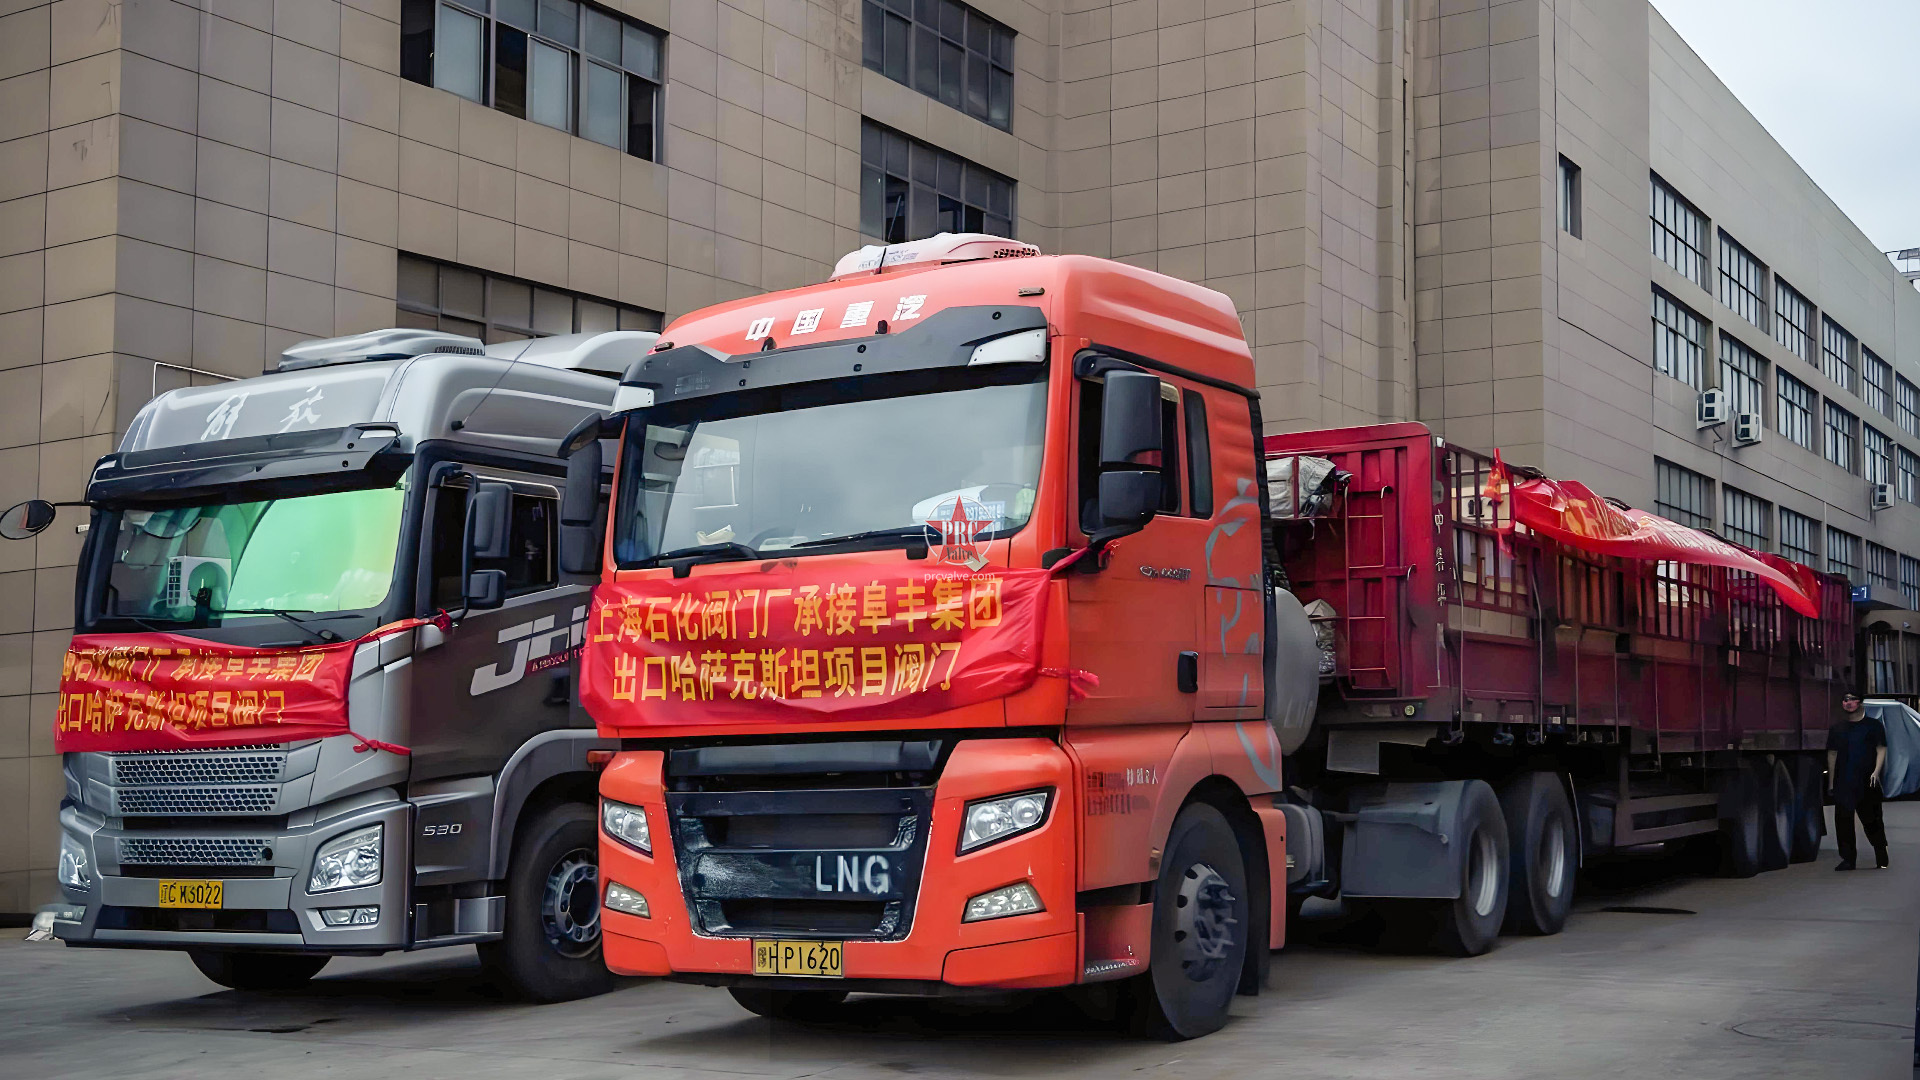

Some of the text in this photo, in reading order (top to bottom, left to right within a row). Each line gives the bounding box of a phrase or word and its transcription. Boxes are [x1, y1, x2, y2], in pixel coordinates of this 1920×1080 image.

[745, 294, 928, 341] 中国重汽
[593, 575, 1004, 643] 上海石化阀门厂 承接阜丰集团
[612, 641, 963, 703] 出口哈萨克斯坦项目阀门
[423, 823, 462, 836] 530
[816, 855, 890, 894] LNG
